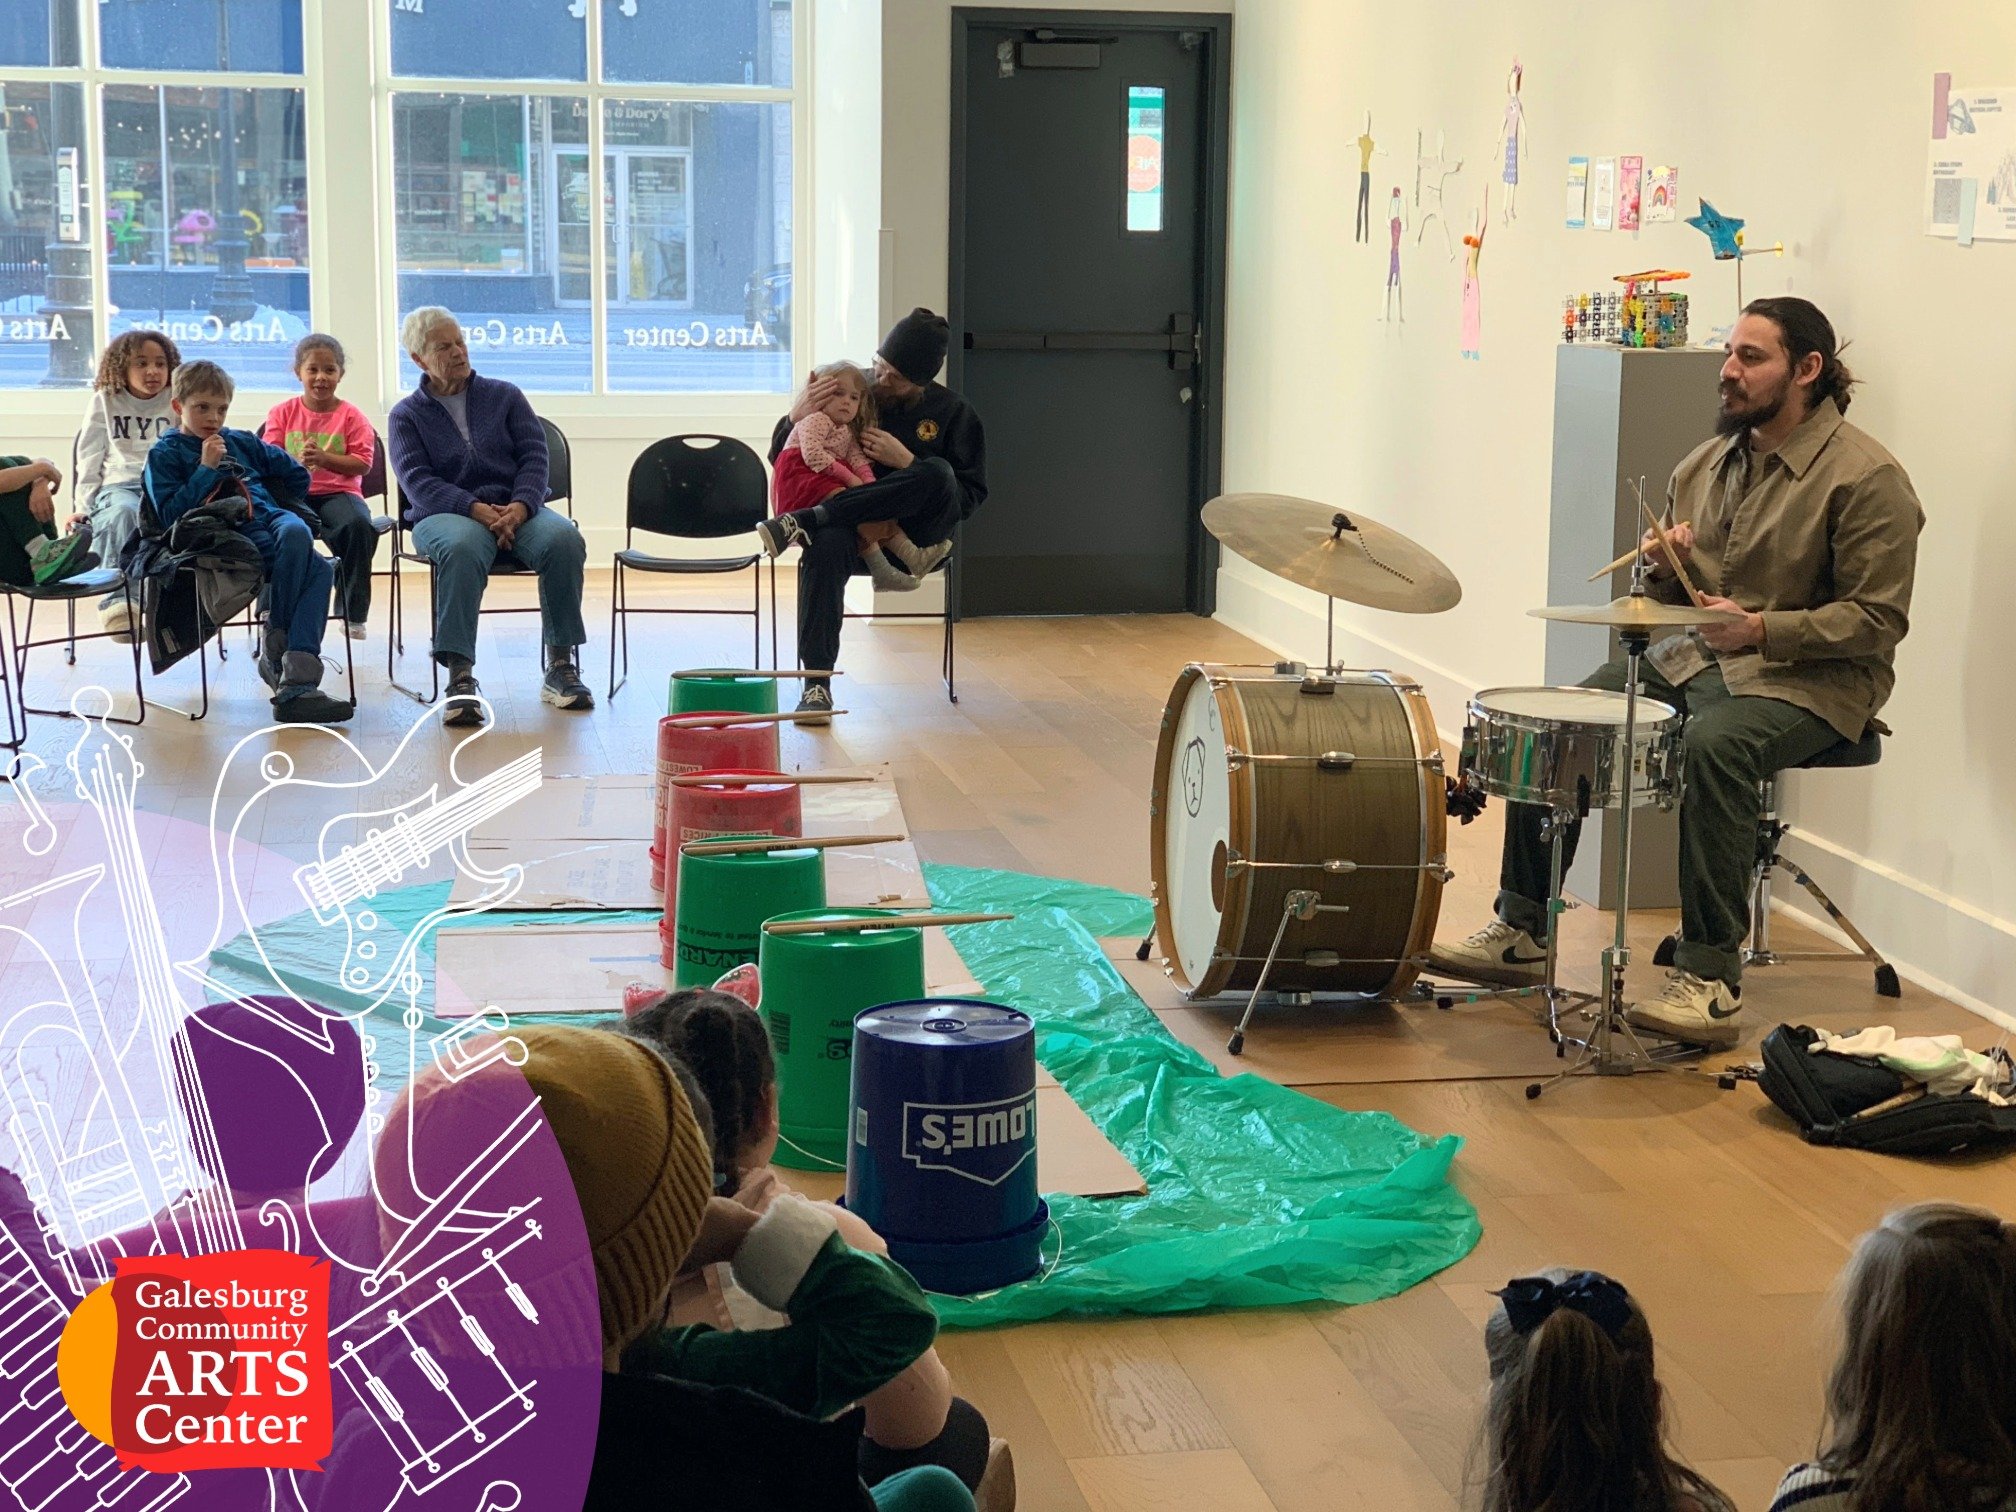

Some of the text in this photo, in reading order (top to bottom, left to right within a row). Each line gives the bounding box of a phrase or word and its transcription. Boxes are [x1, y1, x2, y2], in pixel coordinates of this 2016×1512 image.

[625, 107, 670, 121] Dory's
[113, 415, 171, 440] NYC
[683, 829, 720, 840] RICES
[677, 944, 758, 968] ENARD
[922, 1100, 1035, 1155] LOWE'S
